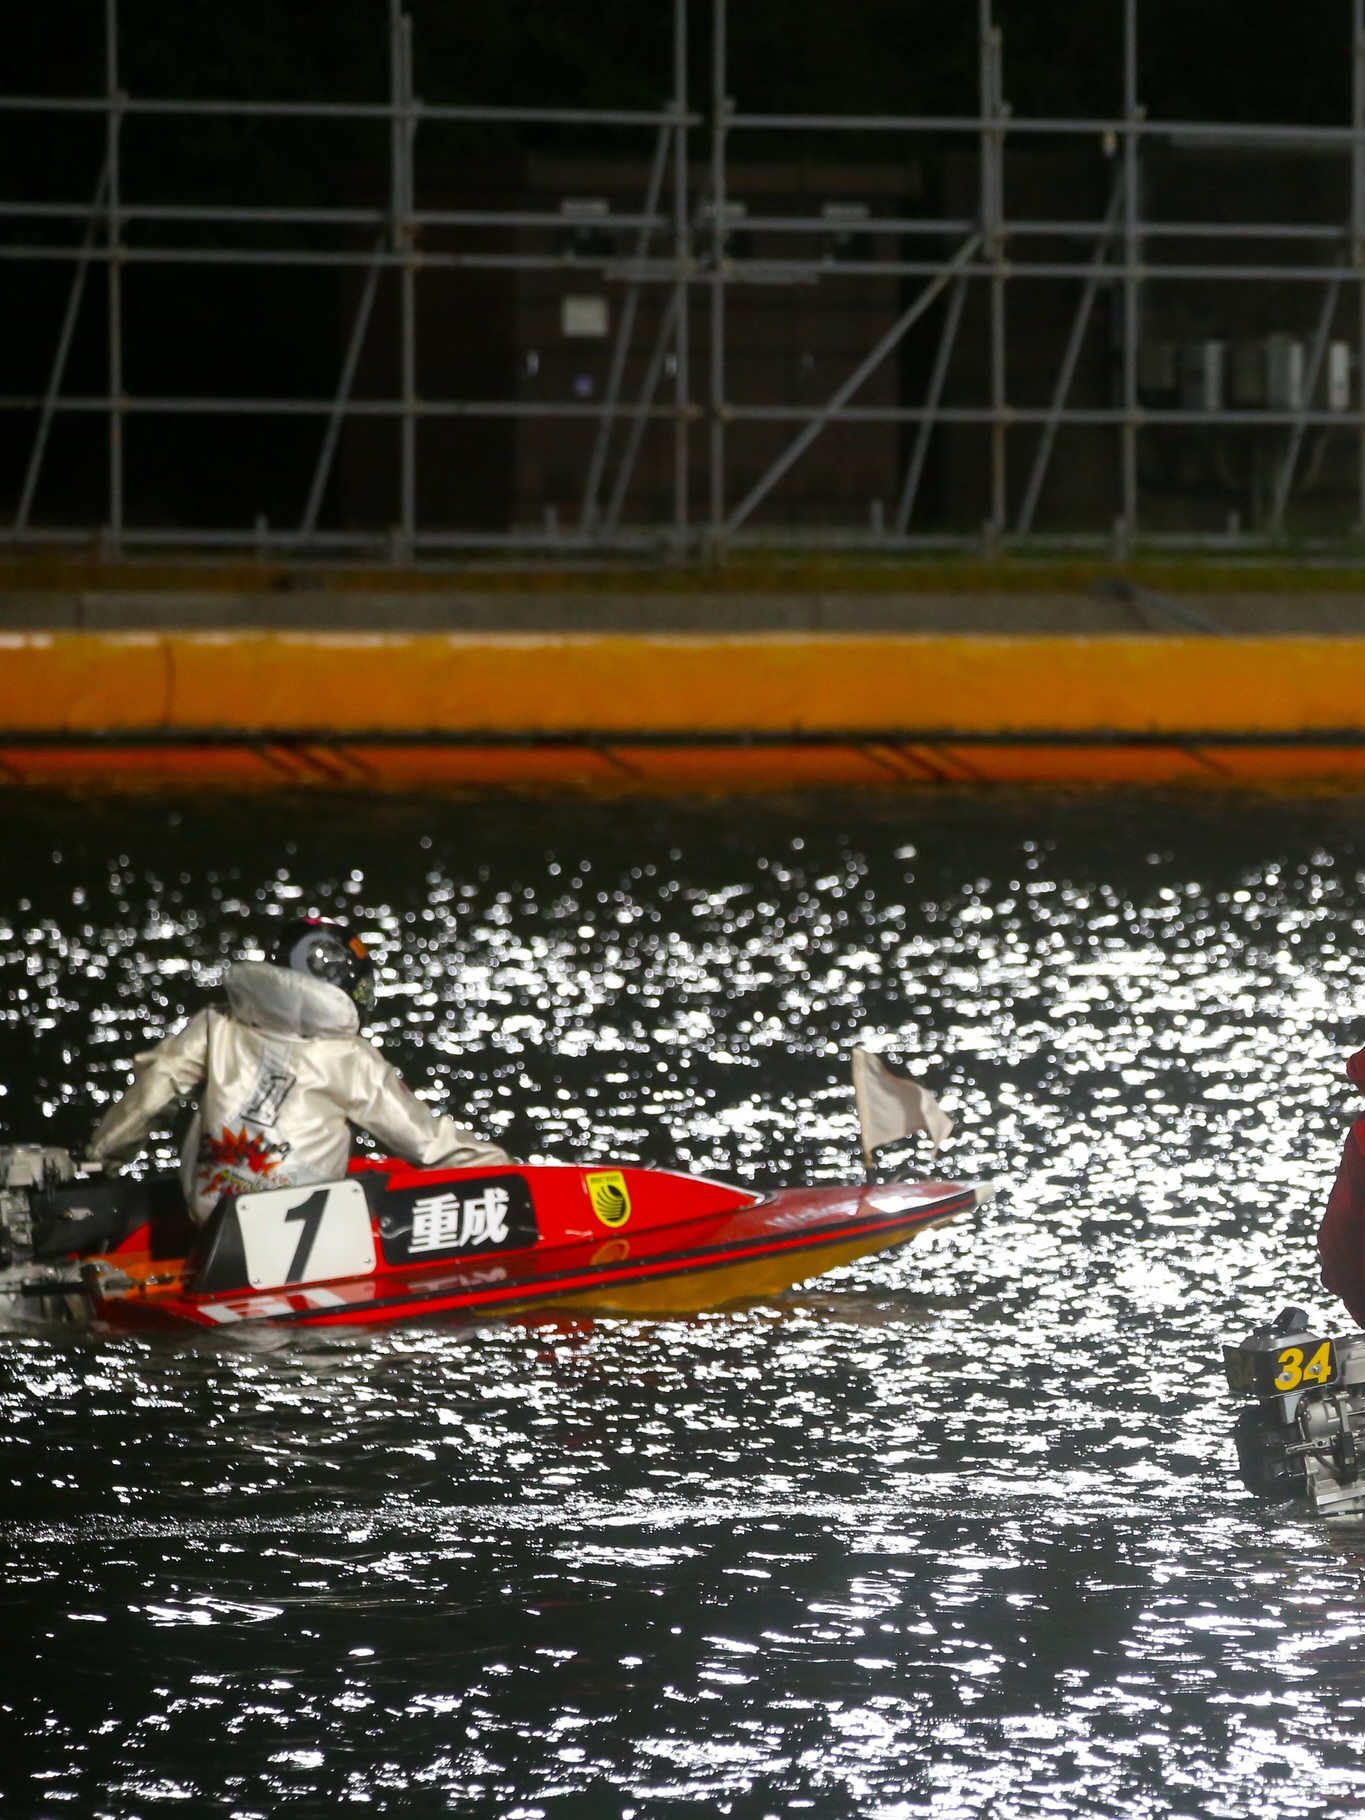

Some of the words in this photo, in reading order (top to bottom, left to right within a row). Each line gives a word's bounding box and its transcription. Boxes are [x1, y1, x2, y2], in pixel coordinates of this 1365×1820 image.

[285, 1190, 330, 1285] 1
[408, 1189, 510, 1254] 重成
[1274, 1341, 1332, 1391] 34
